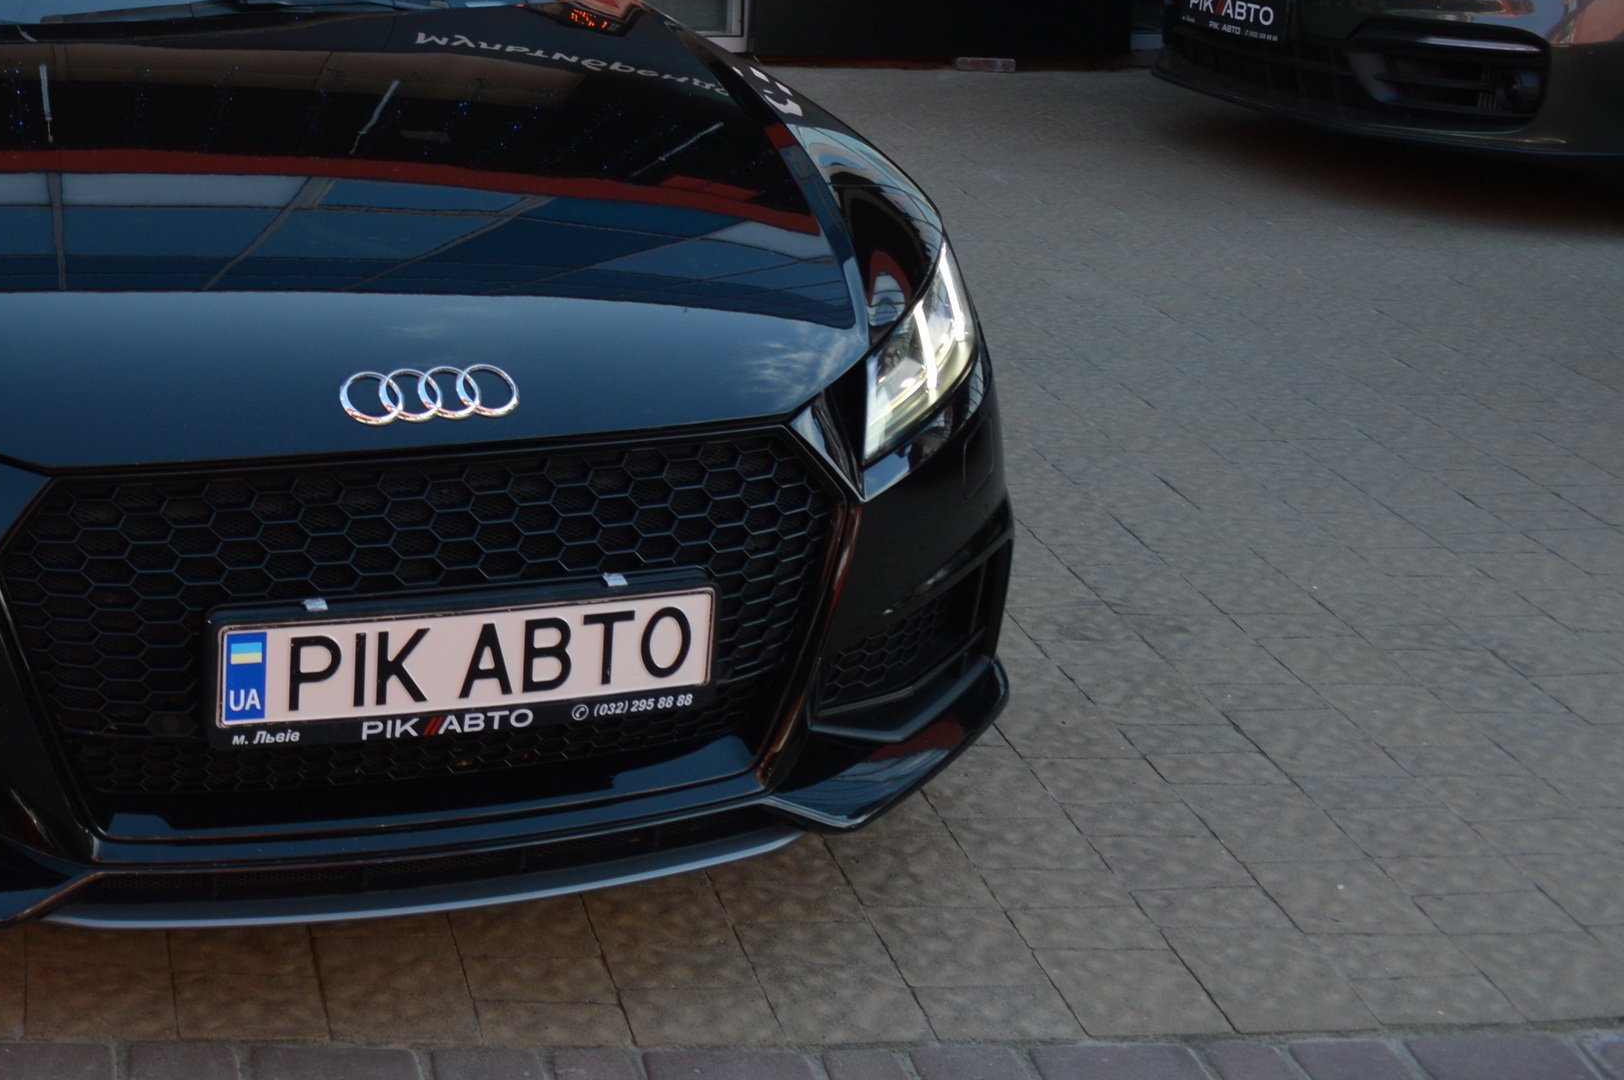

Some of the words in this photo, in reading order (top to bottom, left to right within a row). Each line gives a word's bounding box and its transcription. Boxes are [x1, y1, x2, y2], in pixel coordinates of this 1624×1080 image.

[228, 688, 262, 713] UA
[593, 698, 629, 718] (032)
[630, 696, 654, 714] 295
[656, 694, 675, 711] 88
[676, 693, 693, 709] 88
[253, 728, 301, 745] Львів
